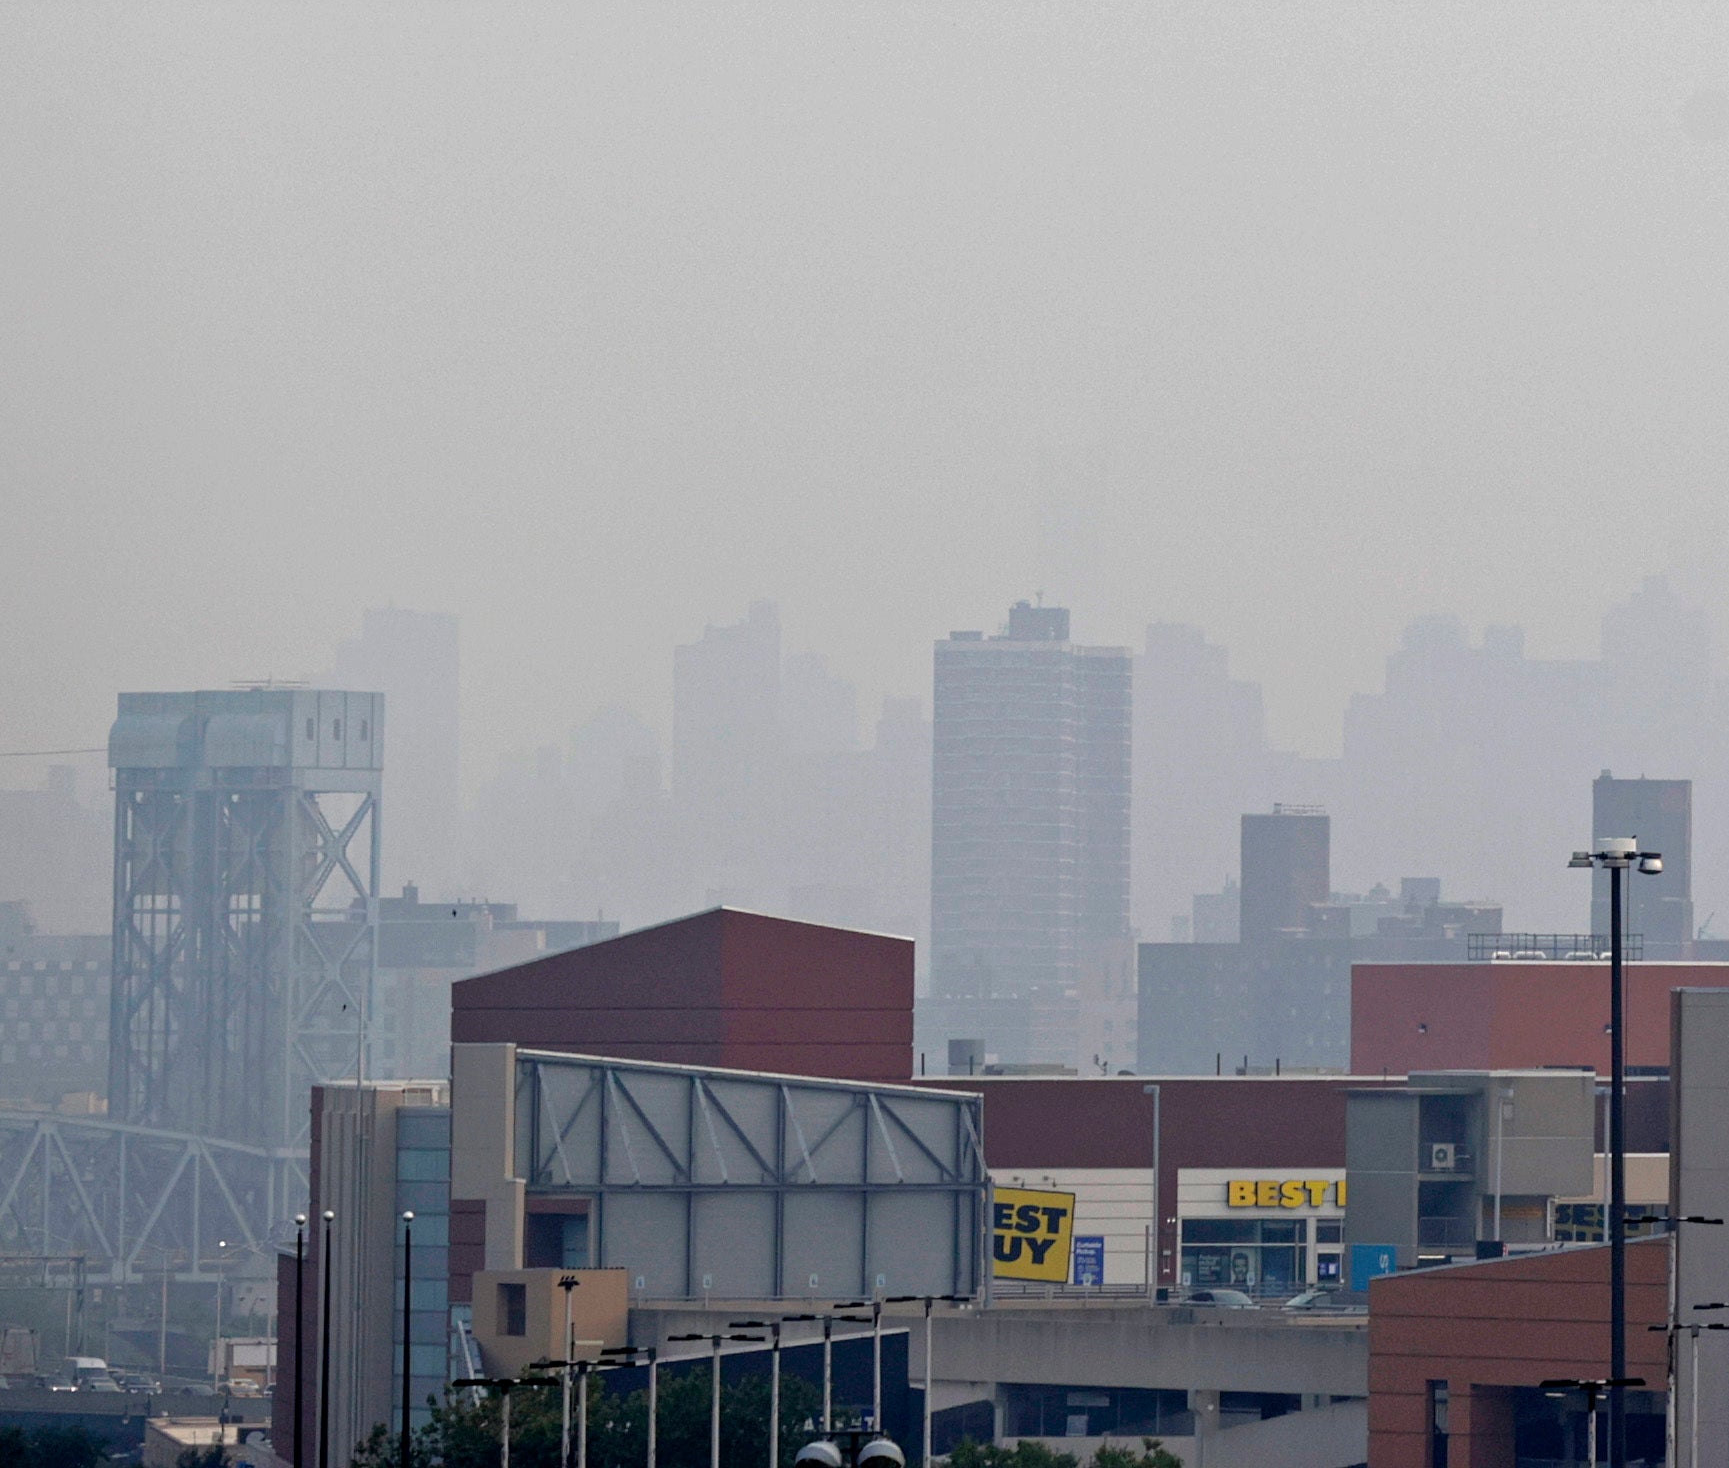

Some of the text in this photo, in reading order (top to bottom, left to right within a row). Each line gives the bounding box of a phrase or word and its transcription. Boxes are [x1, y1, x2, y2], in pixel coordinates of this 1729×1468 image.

[1228, 1180, 1330, 1208] BEST
[994, 1203, 1067, 1234] EST
[994, 1235, 1056, 1265] UY
